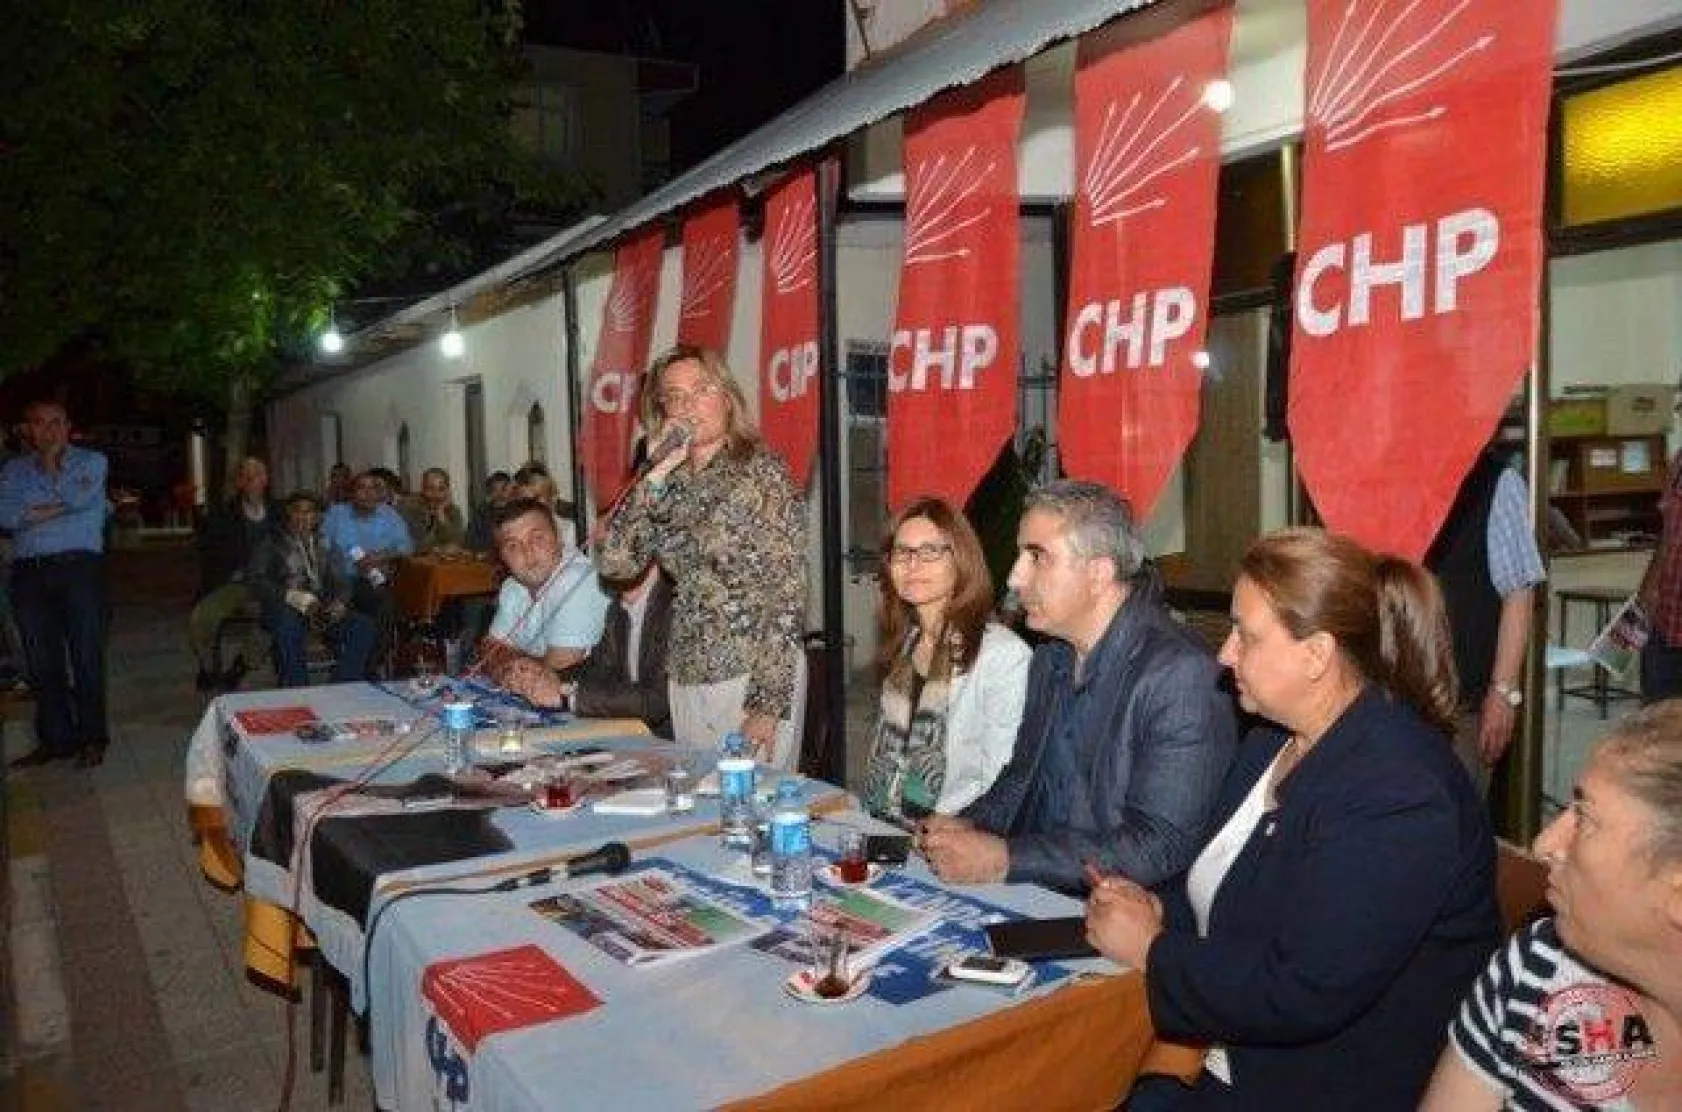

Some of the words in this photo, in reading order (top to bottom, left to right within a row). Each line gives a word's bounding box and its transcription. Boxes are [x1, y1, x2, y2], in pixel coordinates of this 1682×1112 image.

[1298, 208, 1500, 338] CHP
[889, 324, 998, 394] CHP
[1068, 286, 1196, 378] CHP
